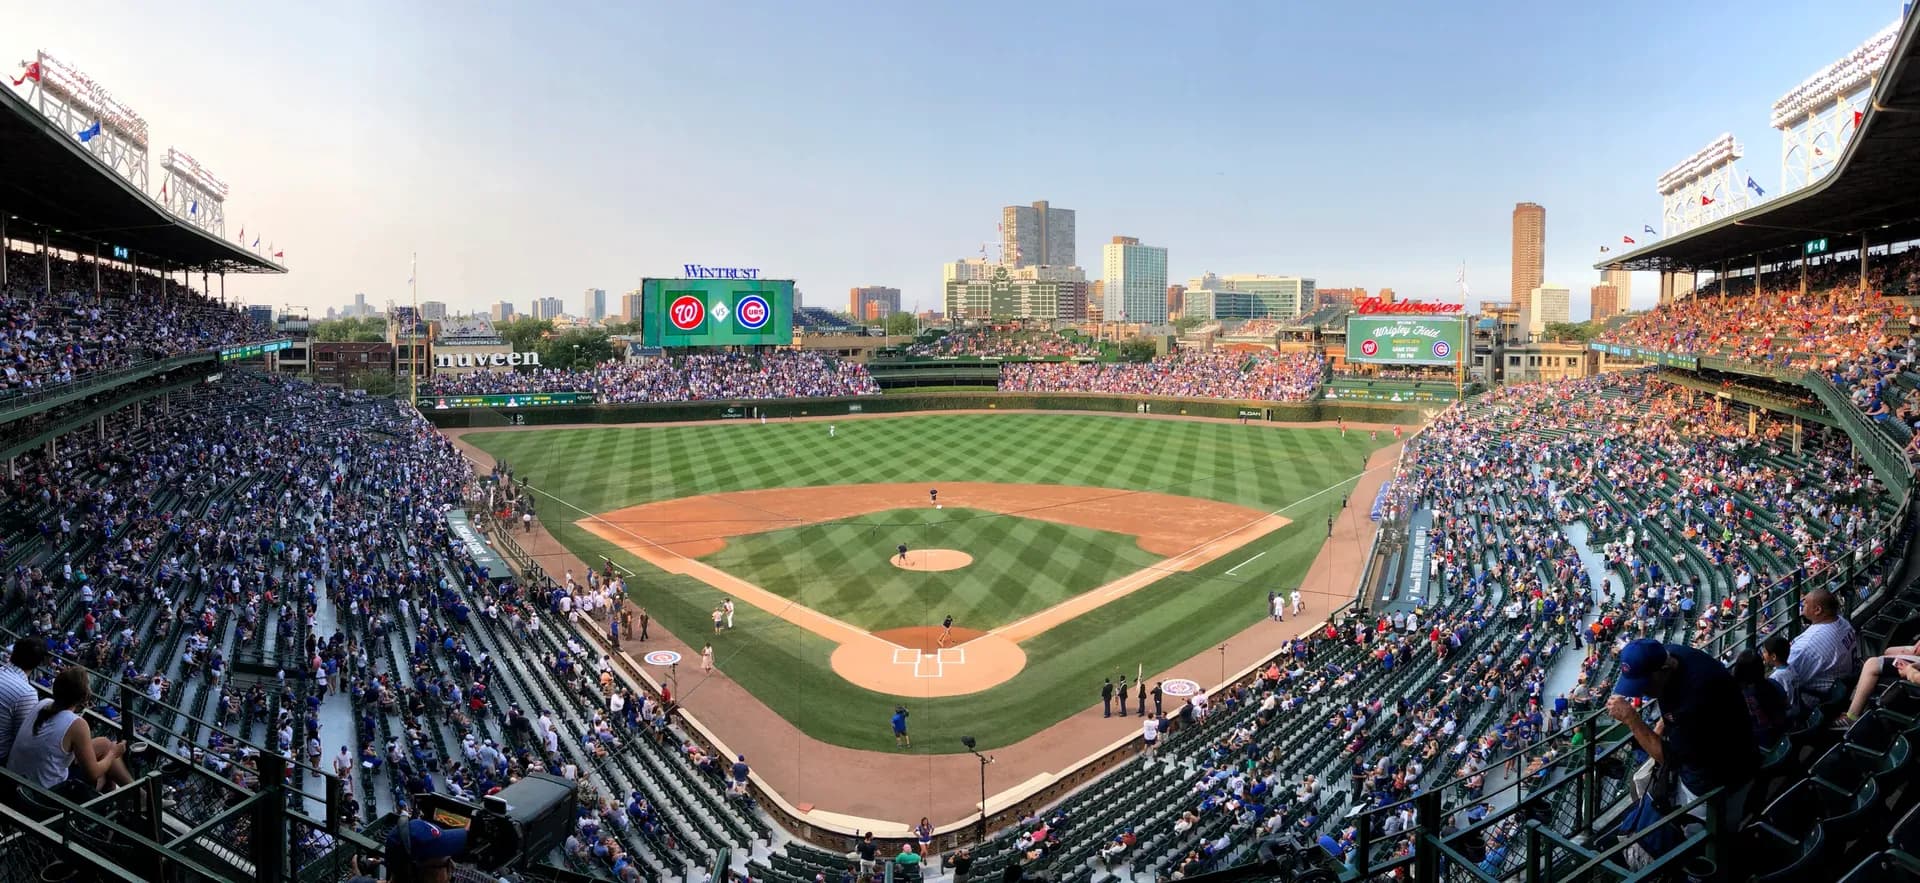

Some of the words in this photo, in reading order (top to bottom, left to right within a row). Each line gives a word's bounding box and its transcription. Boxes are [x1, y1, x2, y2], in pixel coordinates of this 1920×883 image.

[684, 264, 760, 279] WINTRUST
[1353, 296, 1465, 315] Budweiser
[1372, 325, 1411, 338] Wrigley
[1413, 325, 1441, 338] Field
[437, 351, 540, 367] nuveen
